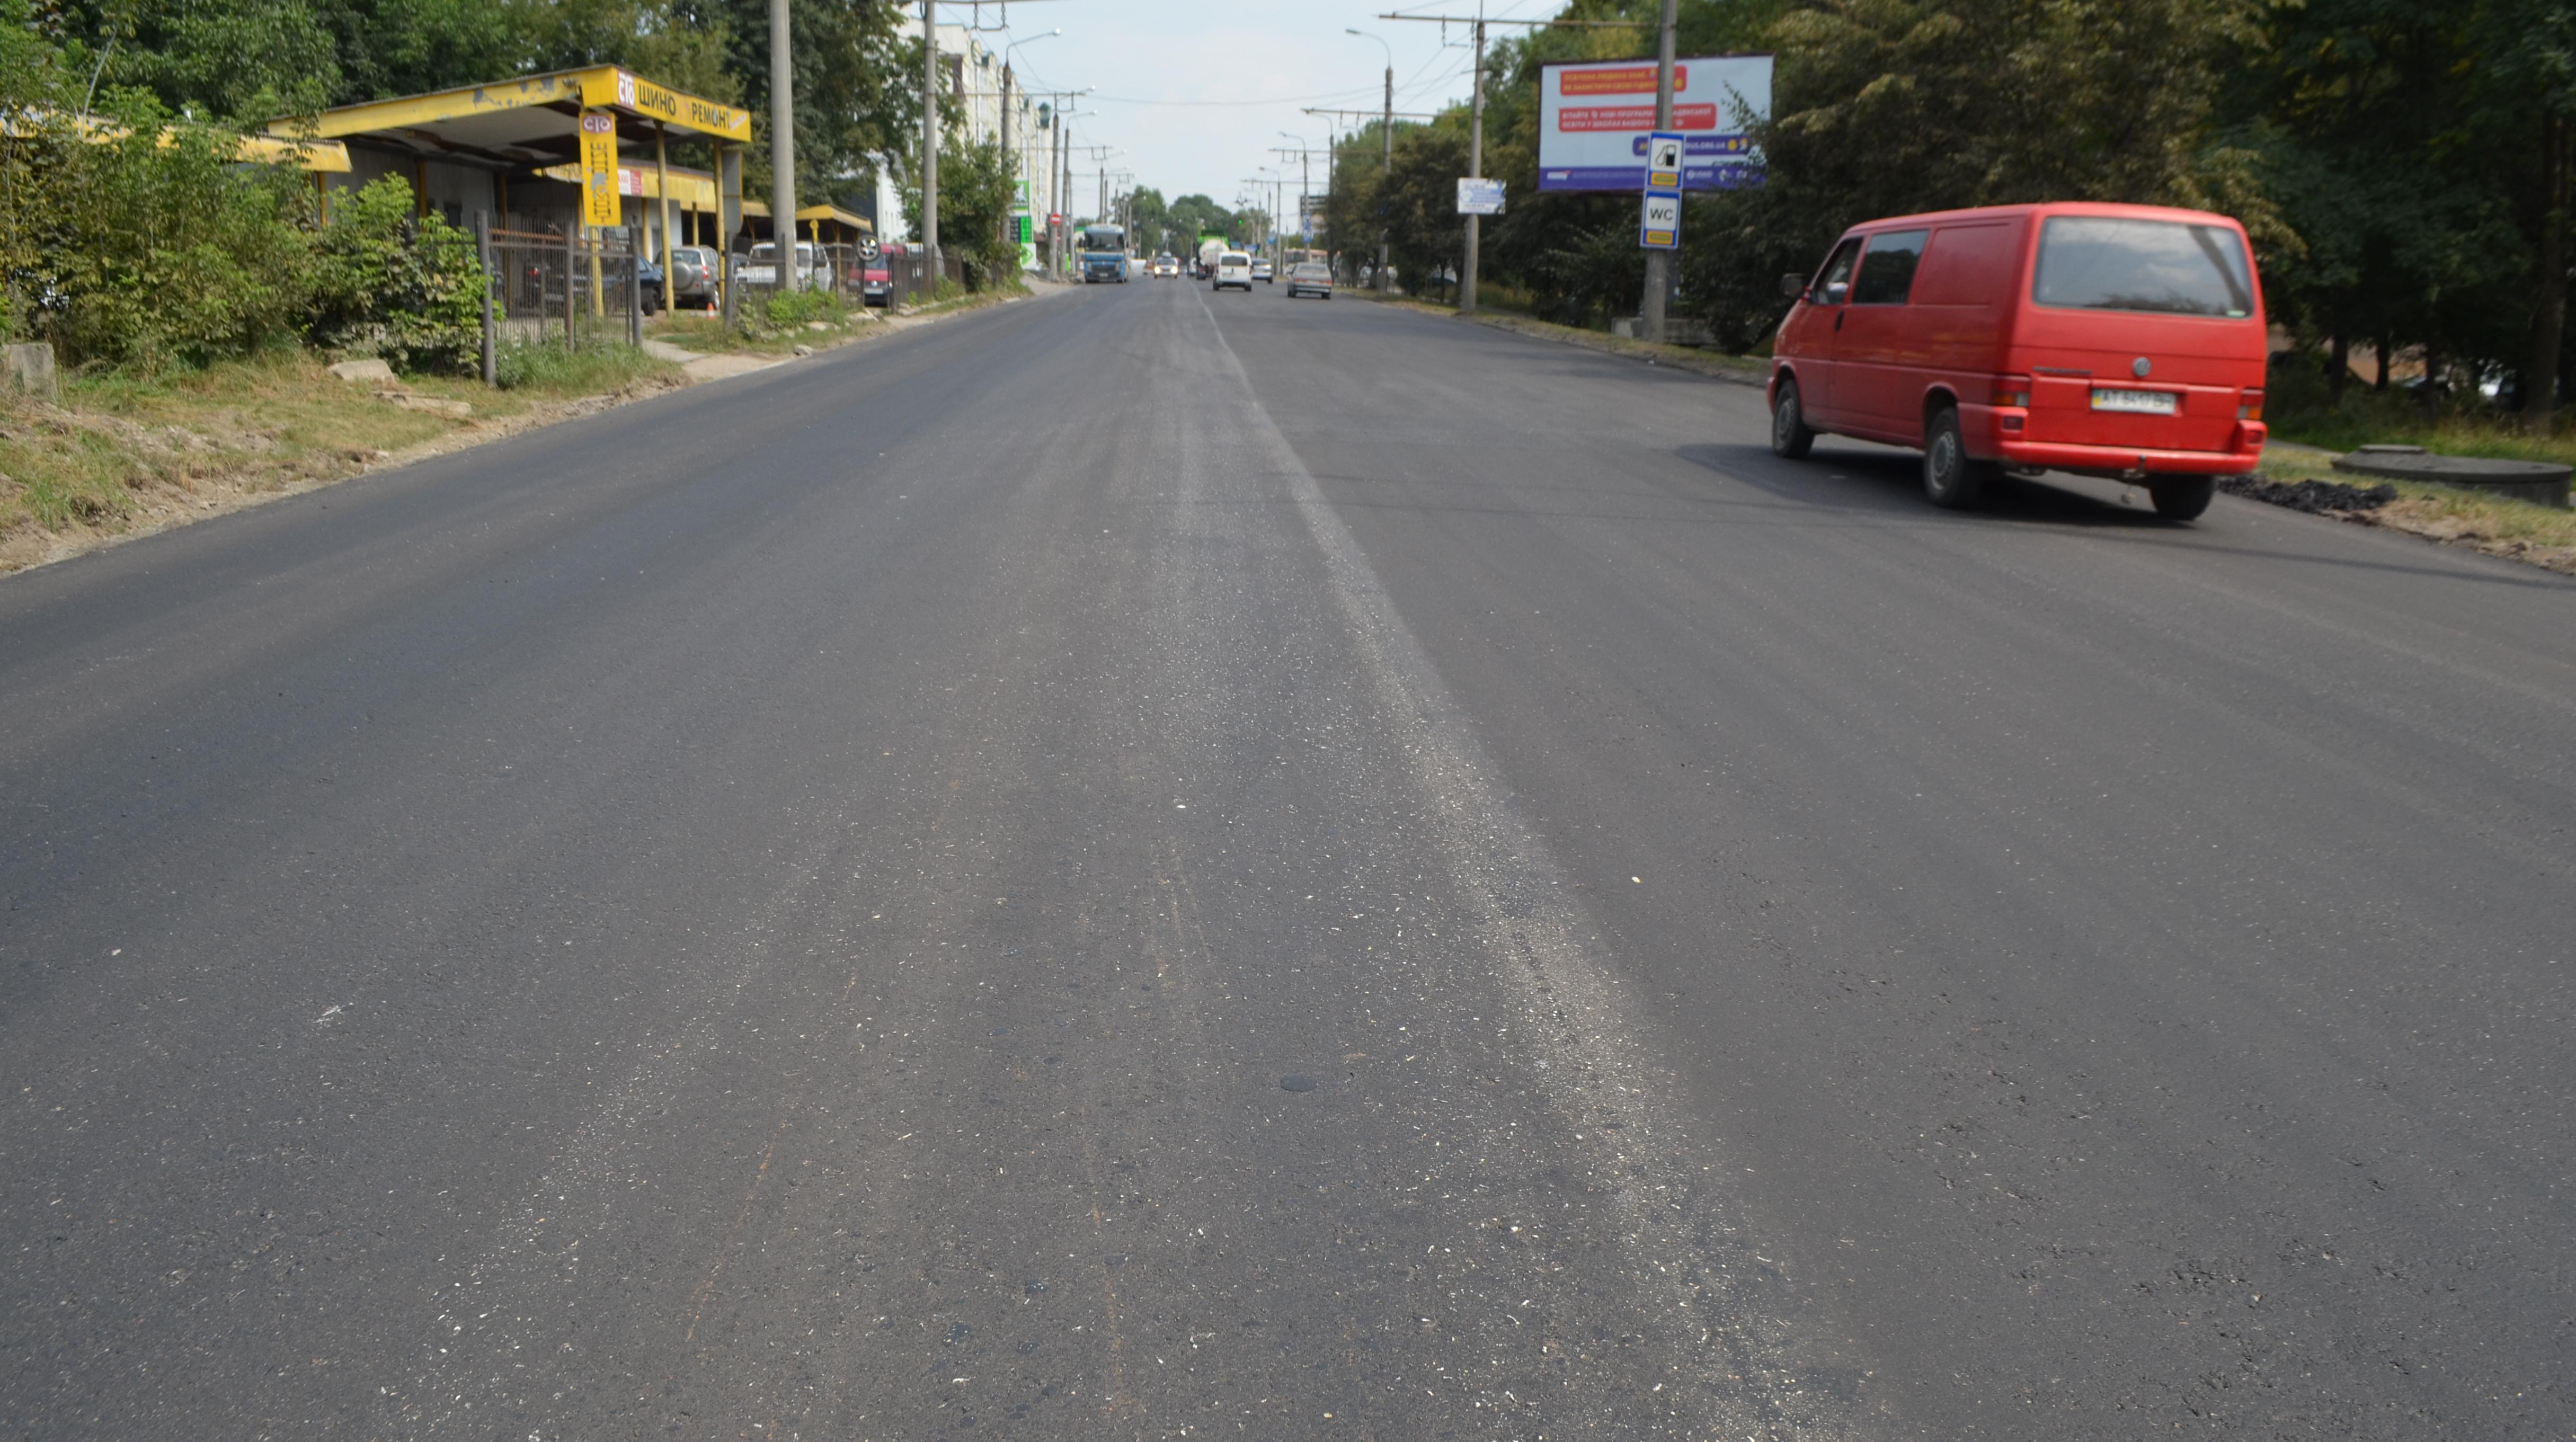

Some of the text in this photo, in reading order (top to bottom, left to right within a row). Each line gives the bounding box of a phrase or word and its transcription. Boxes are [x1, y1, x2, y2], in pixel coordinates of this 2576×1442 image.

[618, 73, 635, 106] СТО
[639, 84, 676, 116] ШИНО
[691, 101, 731, 130] РЕМОНТ
[583, 116, 611, 133] СТО
[1650, 207, 1673, 221] WC
